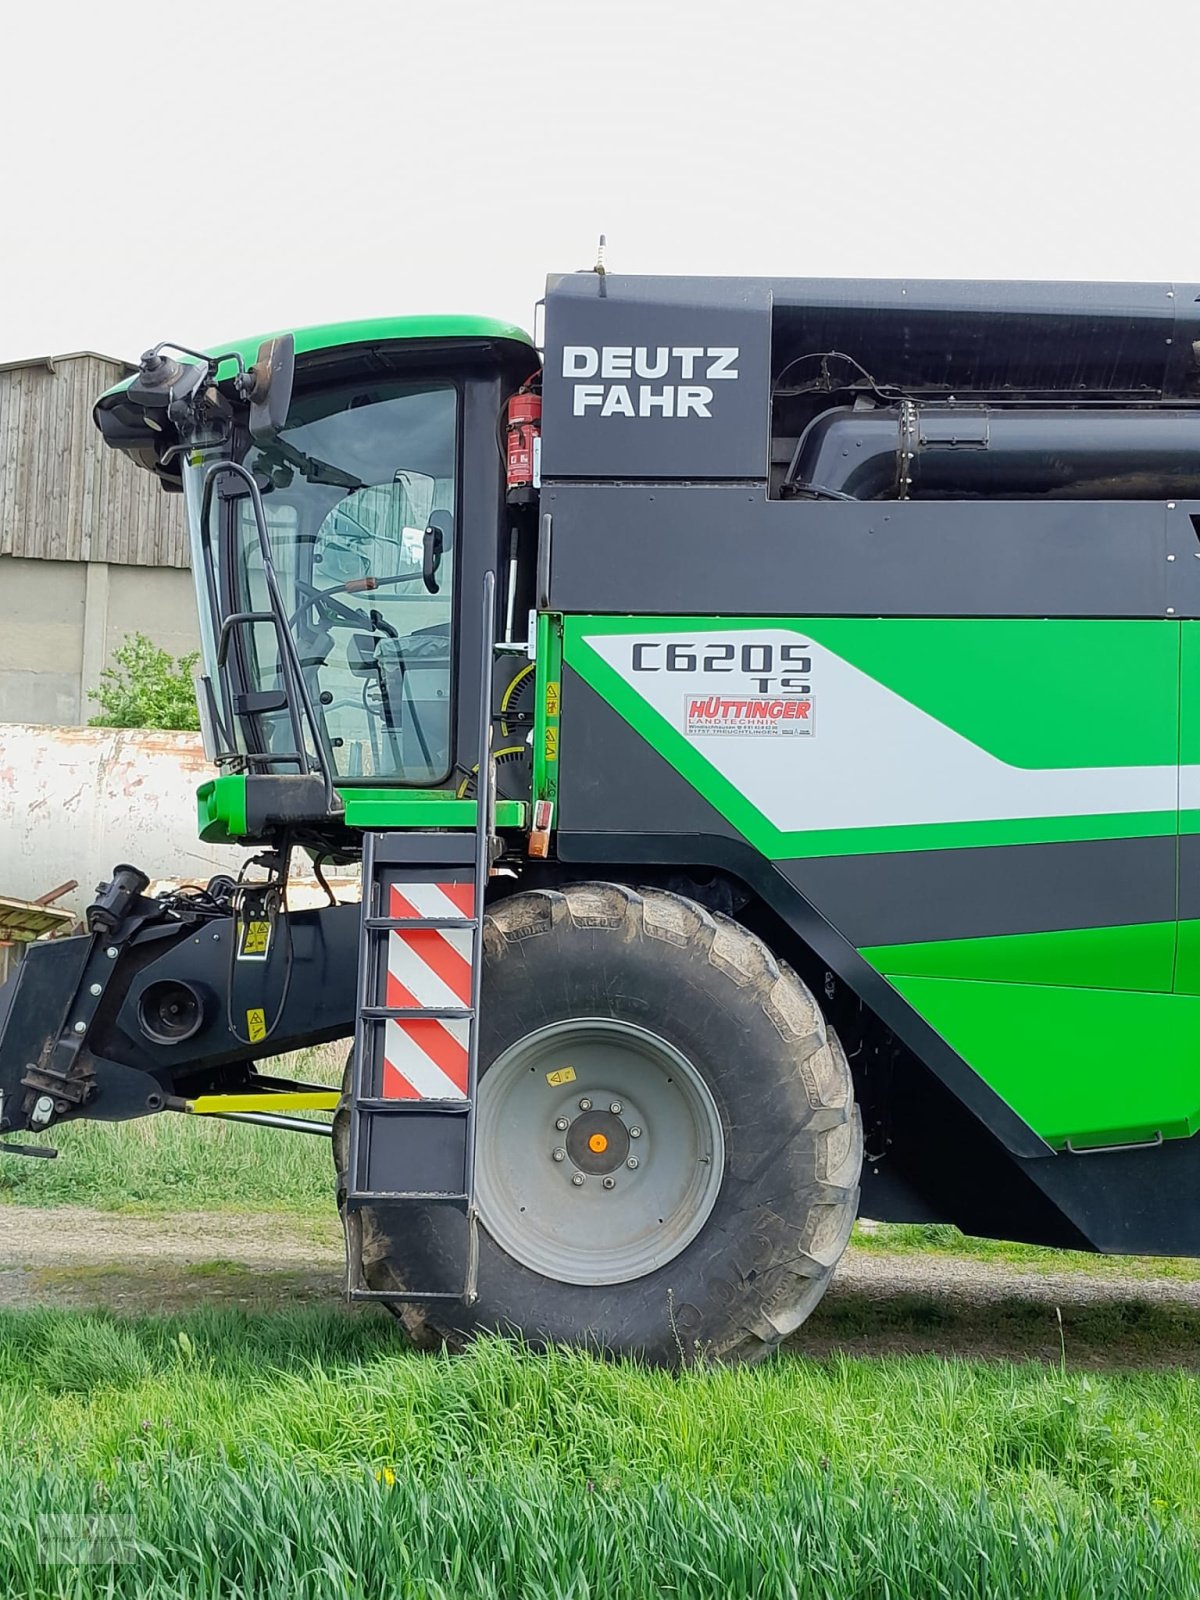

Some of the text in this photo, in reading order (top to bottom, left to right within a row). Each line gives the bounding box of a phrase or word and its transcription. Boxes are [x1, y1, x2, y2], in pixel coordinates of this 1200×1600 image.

[562, 346, 740, 379] DEUTZ
[573, 385, 714, 418] FAHR
[632, 643, 811, 673] C6205
[750, 678, 811, 694] TS
[689, 697, 811, 719] HÜTTINGER
